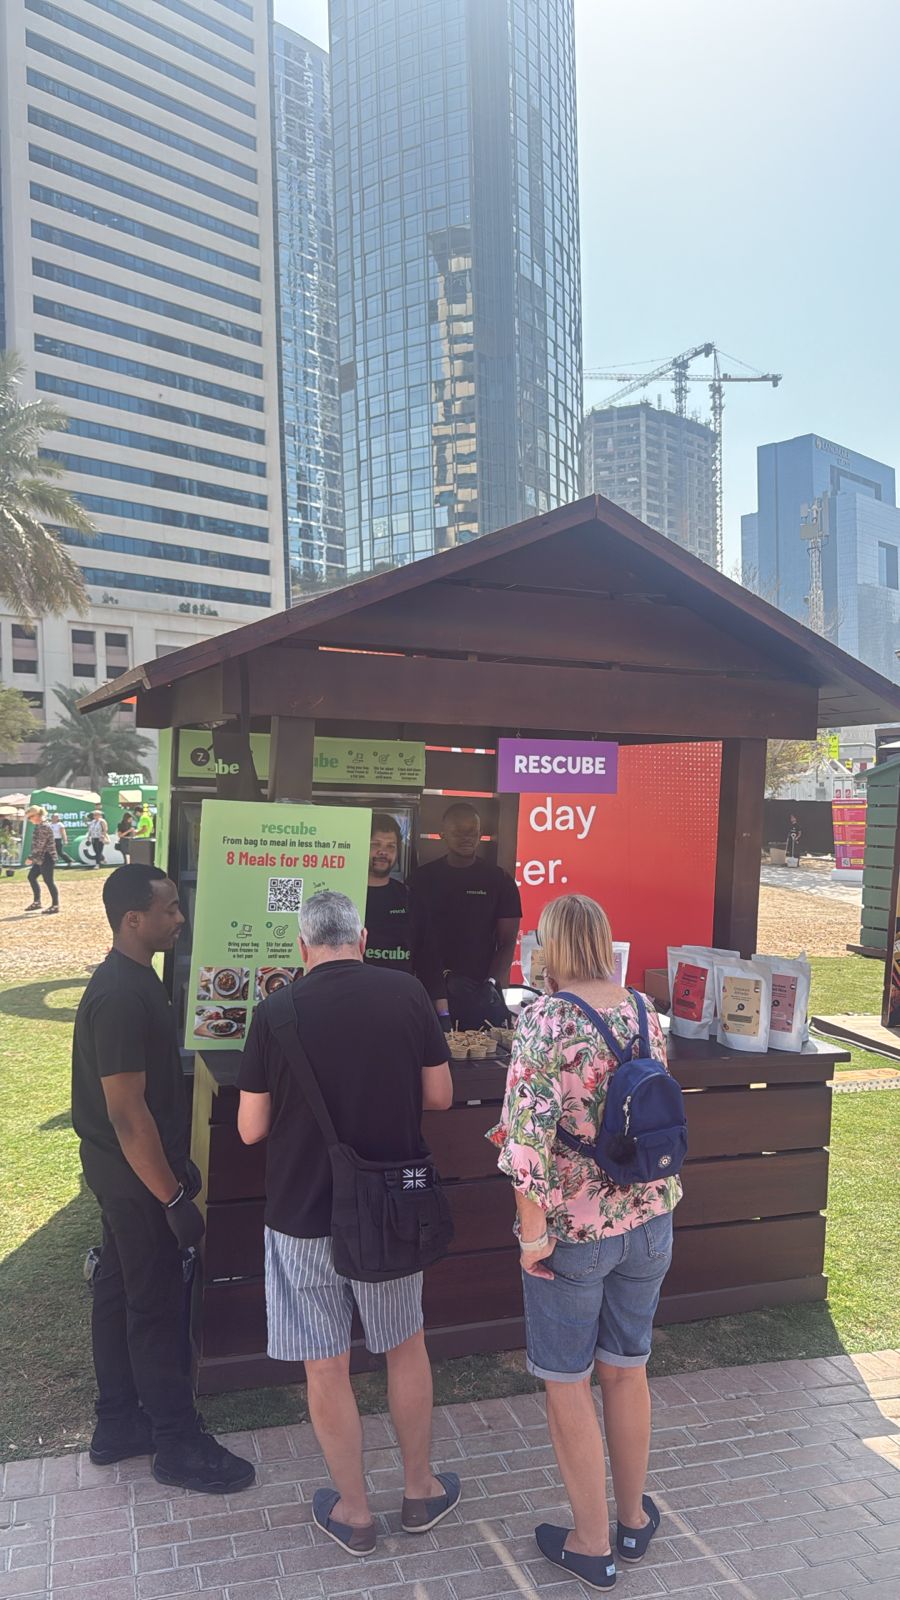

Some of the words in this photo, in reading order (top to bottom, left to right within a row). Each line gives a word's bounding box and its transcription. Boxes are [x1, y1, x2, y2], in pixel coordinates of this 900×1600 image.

[514, 755, 606, 775] RESCUBE
[529, 797, 597, 839] day
[261, 822, 317, 836] rescube
[222, 836, 242, 846] From
[243, 837, 259, 848] bag
[259, 838, 268, 847] to
[269, 838, 288, 848] meal
[289, 839, 296, 848] in
[297, 839, 313, 849] less
[314, 840, 331, 849] than
[331, 841, 337, 849] 7
[337, 841, 351, 850] min
[226, 851, 235, 865] 8
[239, 852, 277, 867] Meals
[280, 853, 299, 867] for
[302, 854, 319, 868] 99
[321, 855, 346, 869] AED
[365, 946, 411, 960] escube
